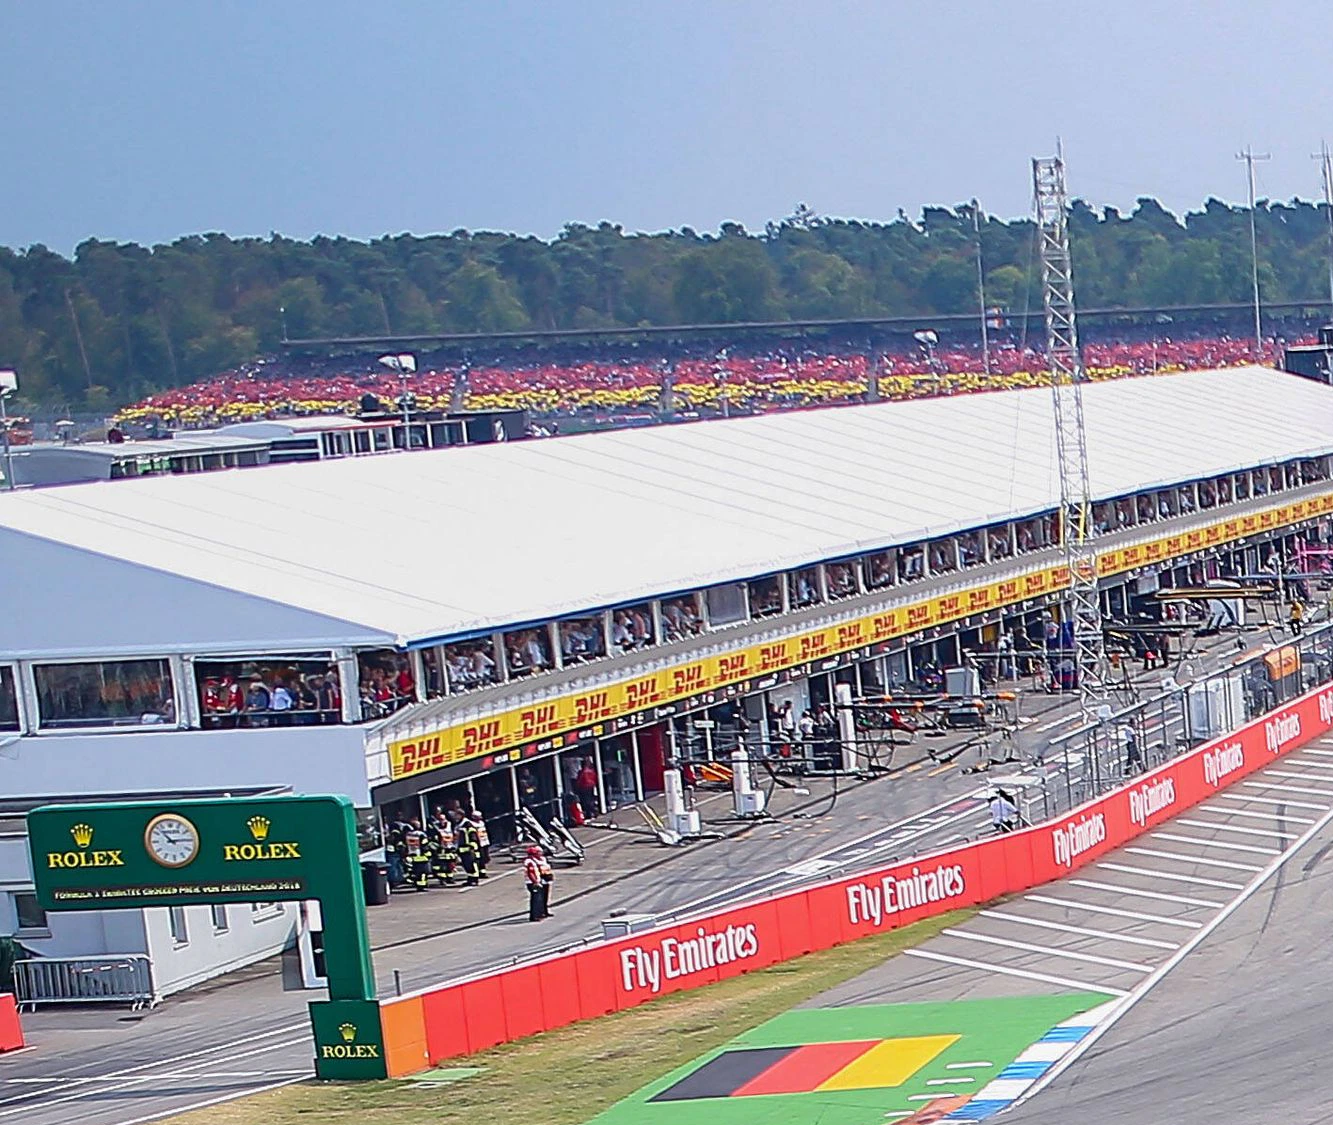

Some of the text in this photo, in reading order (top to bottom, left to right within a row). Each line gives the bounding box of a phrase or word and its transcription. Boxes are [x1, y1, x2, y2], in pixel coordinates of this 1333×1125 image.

[760, 644, 789, 670] DHL
[800, 633, 828, 659] DHL
[674, 665, 707, 694] DHL
[719, 654, 750, 683] DHL
[576, 692, 609, 723] DHL
[626, 678, 660, 709] DHL
[521, 705, 559, 738] DHL
[1265, 712, 1301, 753] Fly Emirates
[463, 720, 504, 756] DHL
[401, 737, 443, 773] DHL
[1203, 742, 1244, 786] Fly Emirates
[1129, 777, 1175, 827] Fly Emirates
[224, 843, 301, 860] ROLEX
[1052, 813, 1106, 867] Fly Emirates
[49, 850, 125, 868] ROLEX
[846, 865, 964, 926] Fly Emirates
[620, 924, 758, 993] Fly Emirates
[322, 1045, 379, 1058] ROLEX
